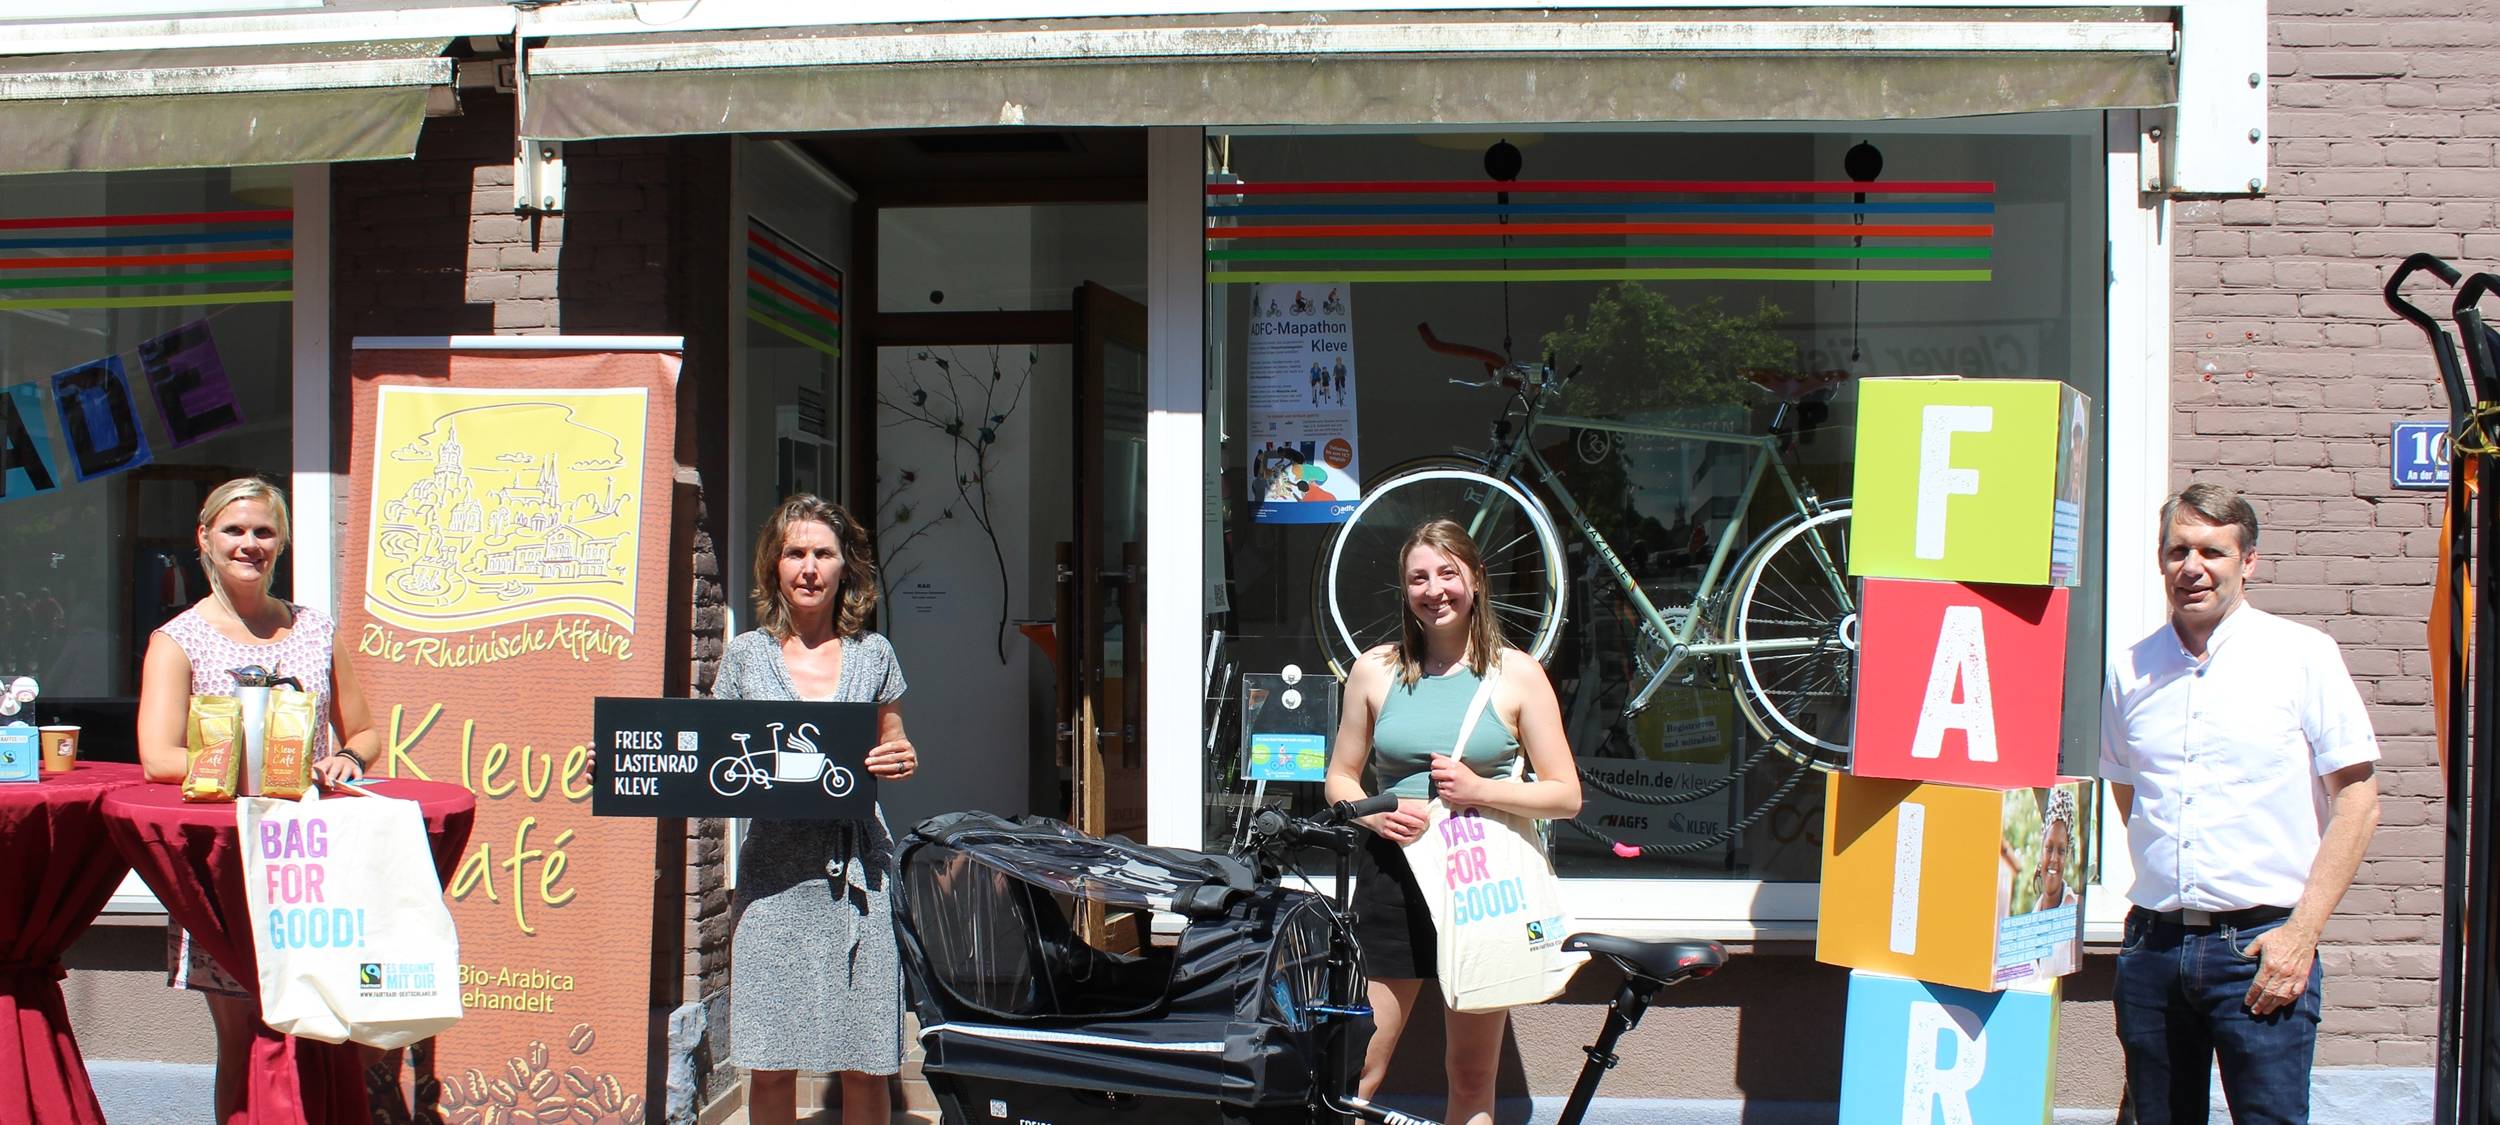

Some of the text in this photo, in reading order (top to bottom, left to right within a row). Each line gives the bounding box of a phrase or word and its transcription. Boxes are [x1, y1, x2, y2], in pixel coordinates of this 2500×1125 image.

[1250, 320, 1346, 337] ADFC-Mapathon
[1311, 339, 1348, 352] Kleve
[2407, 470, 2418, 480] An
[2420, 469, 2433, 480] der
[1583, 519, 1628, 581] GAZELLE
[359, 618, 634, 668] Die Rheinische Affaire
[388, 702, 594, 800] Kleve
[615, 730, 663, 750] FREIES
[615, 754, 698, 773] LASTENRAD
[614, 777, 659, 796] KLEVE
[1587, 767, 1720, 790] dtradeln.de/kleve
[1618, 815, 1648, 830] AGFS
[1686, 820, 1720, 836] KLEVE
[260, 818, 328, 859] BAG
[451, 816, 575, 934] afé
[1446, 846, 1491, 891] FOR
[265, 863, 325, 904] FOR
[1453, 876, 1528, 926] GOOD!
[269, 907, 366, 950] GOOD!
[386, 974, 436, 989] MIT DIR
[458, 964, 575, 991] Bio-Arabica
[462, 987, 555, 1013] ehandelt
